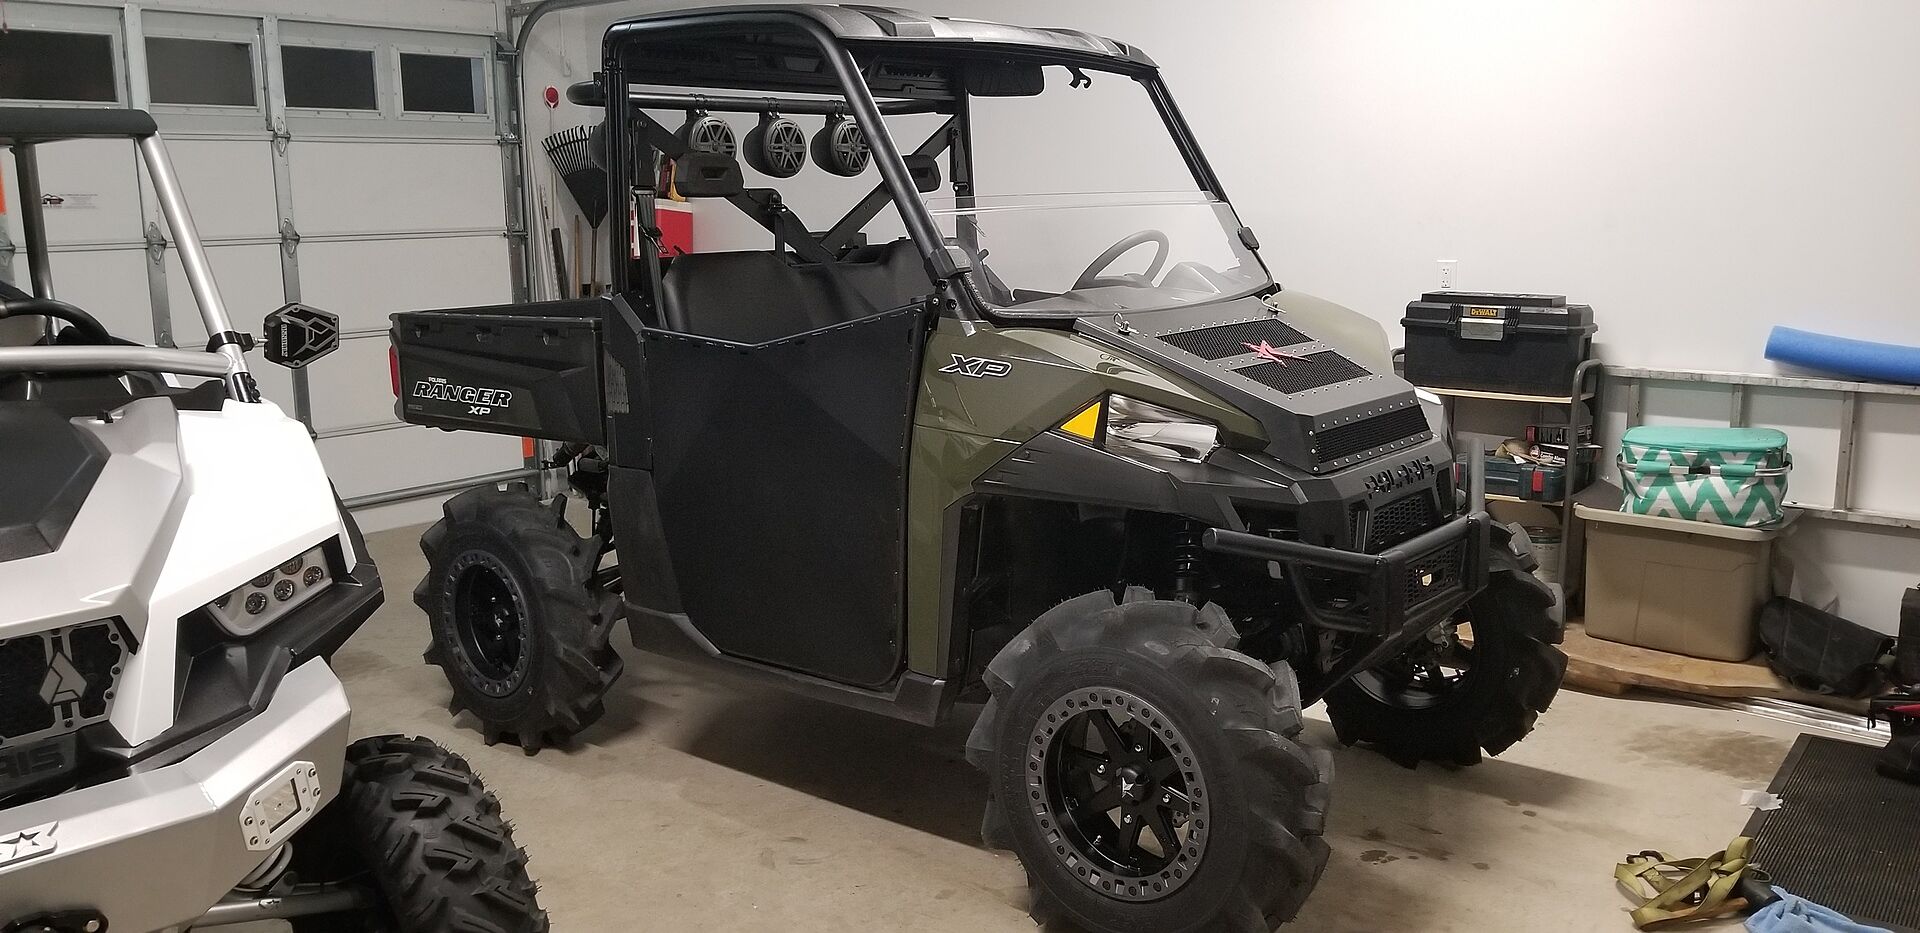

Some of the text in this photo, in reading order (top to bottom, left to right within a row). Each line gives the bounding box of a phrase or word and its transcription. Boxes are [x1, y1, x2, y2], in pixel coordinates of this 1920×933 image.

[938, 353, 1012, 378] XP
[412, 381, 513, 408] RANGER
[467, 405, 491, 415] XP
[1365, 456, 1435, 499] POLARIS
